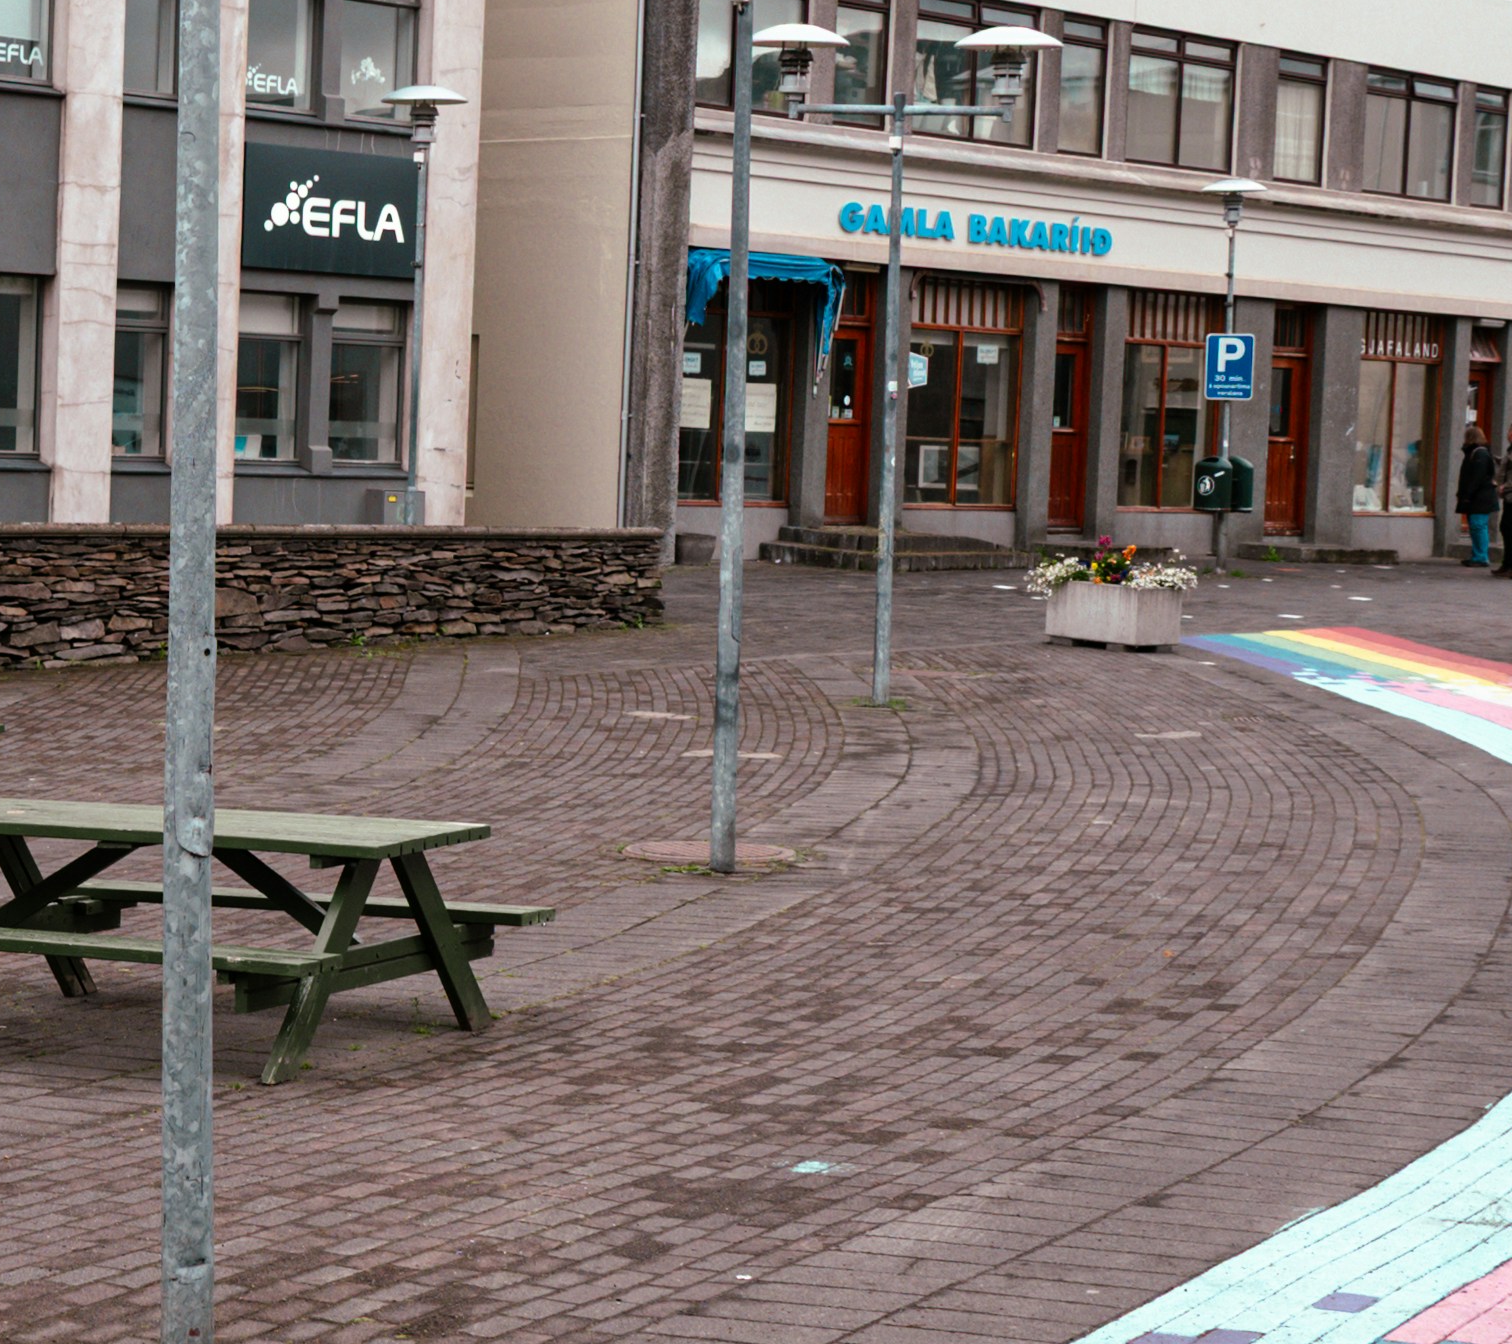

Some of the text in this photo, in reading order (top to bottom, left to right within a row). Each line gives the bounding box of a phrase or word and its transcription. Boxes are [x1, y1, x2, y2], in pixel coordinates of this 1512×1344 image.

[253, 73, 299, 97] EFLA
[302, 196, 405, 244] EFLA
[839, 202, 1113, 257] GAMLA BAKARÍIÐ
[1217, 337, 1246, 372] P
